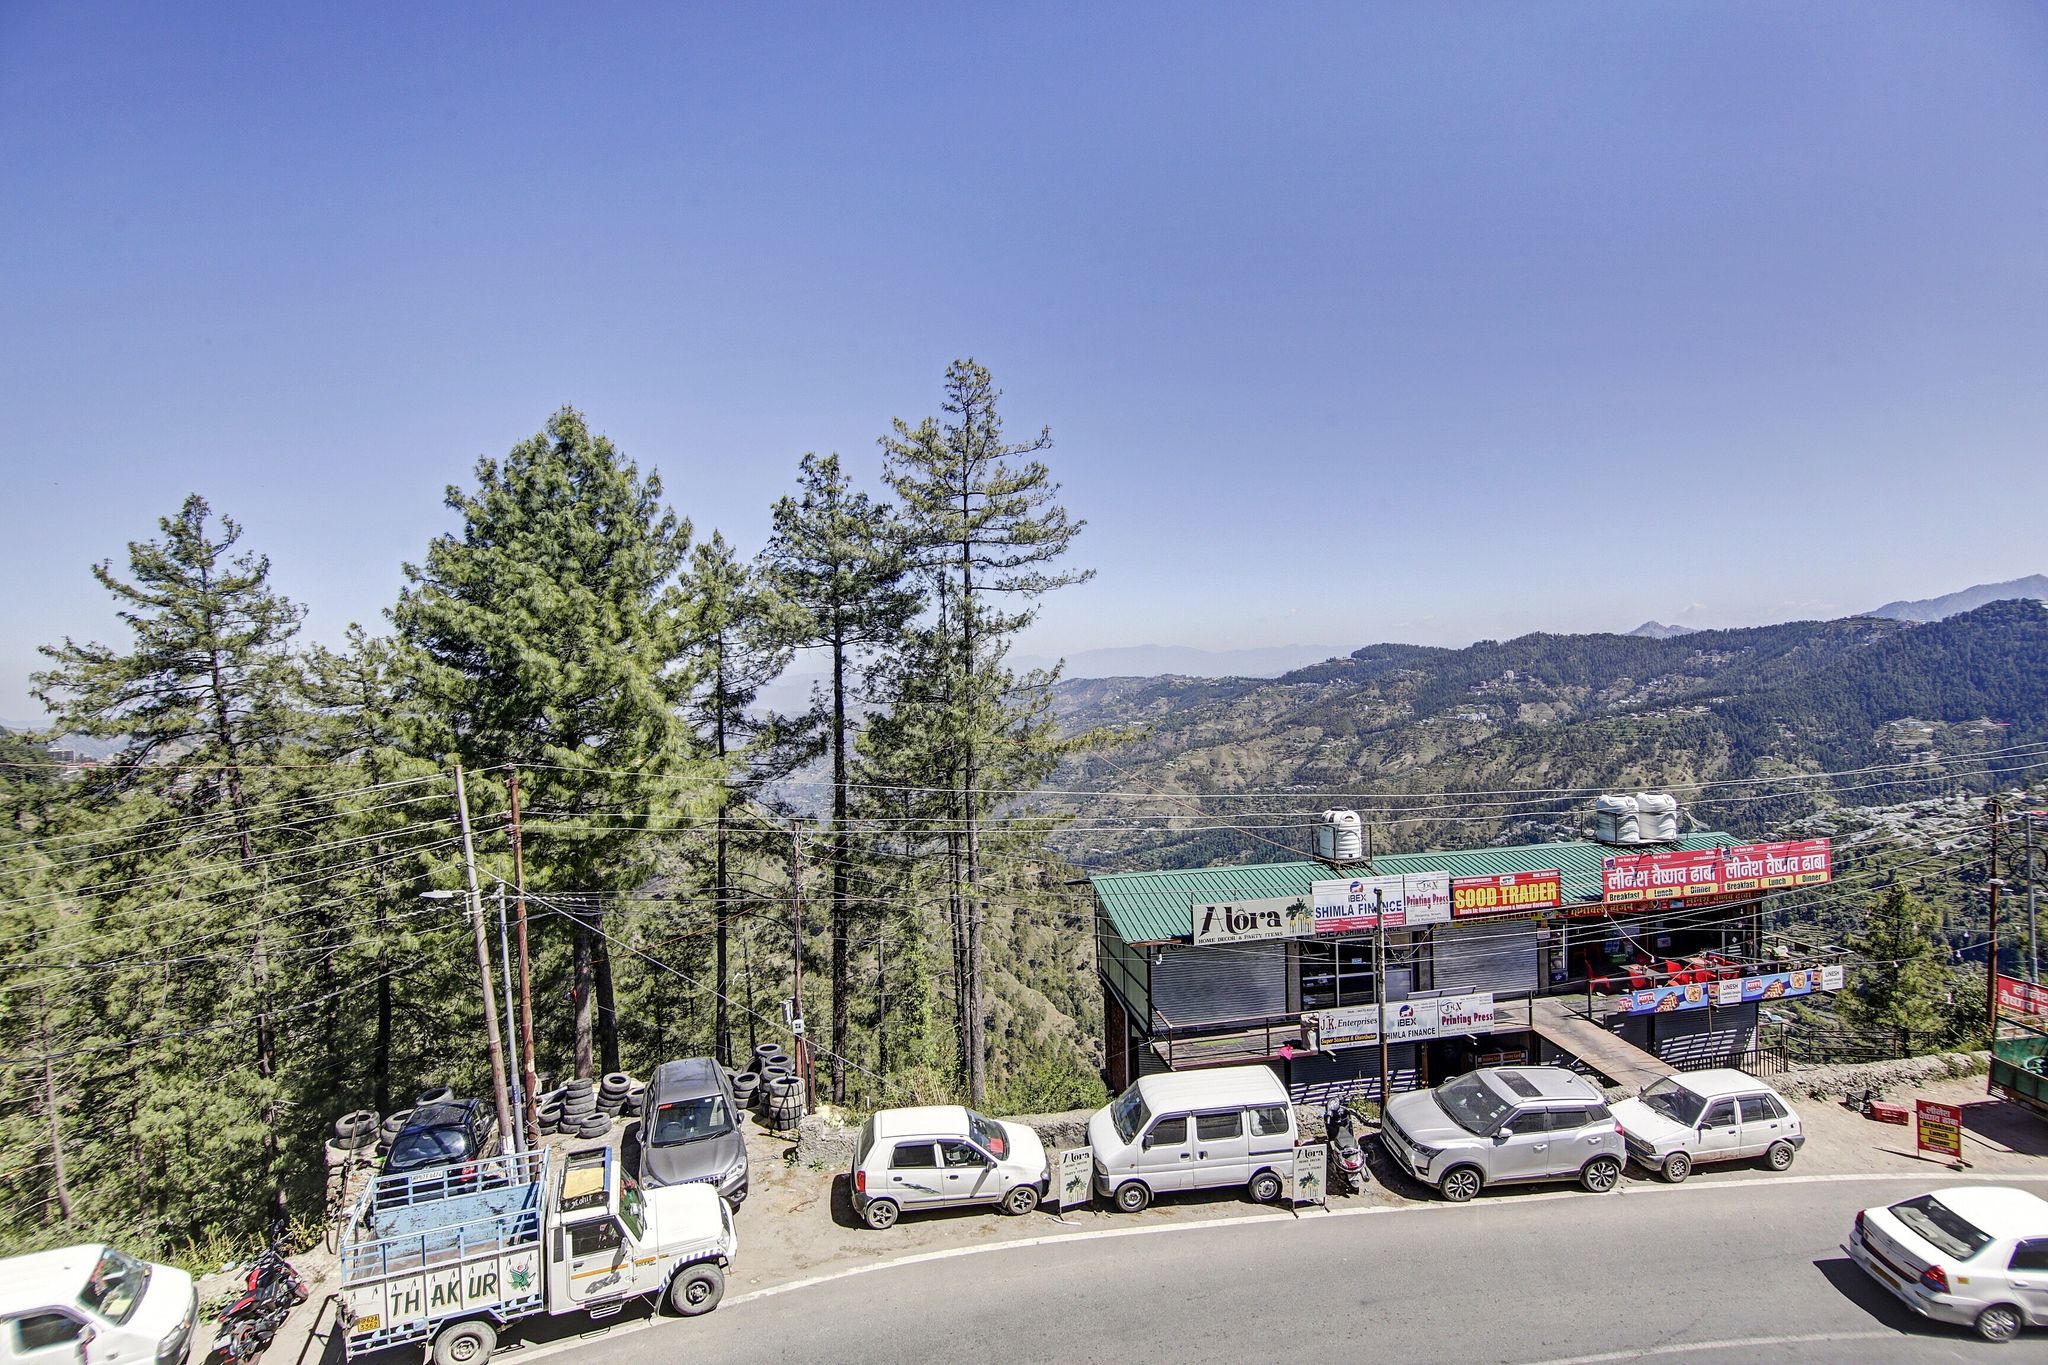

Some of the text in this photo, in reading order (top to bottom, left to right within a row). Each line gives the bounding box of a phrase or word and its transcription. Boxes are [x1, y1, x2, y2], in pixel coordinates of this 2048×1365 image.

[1727, 874, 1821, 890] Breakfast Lunch Dinner
[1455, 881, 1557, 908] SOOD TRADER
[1609, 885, 1711, 902] Breakfast Lunch Dinner
[1407, 894, 1449, 909] Printing Press
[1315, 900, 1402, 919] SHIMLA FINNCE
[1320, 1017, 1378, 1031] J.K. Enterprises
[1442, 1012, 1493, 1026] Printing Press
[1386, 1031, 1407, 1040] HIMLA
[1408, 1027, 1436, 1038] FINANCE
[1922, 1120, 1955, 1132] Breakfast
